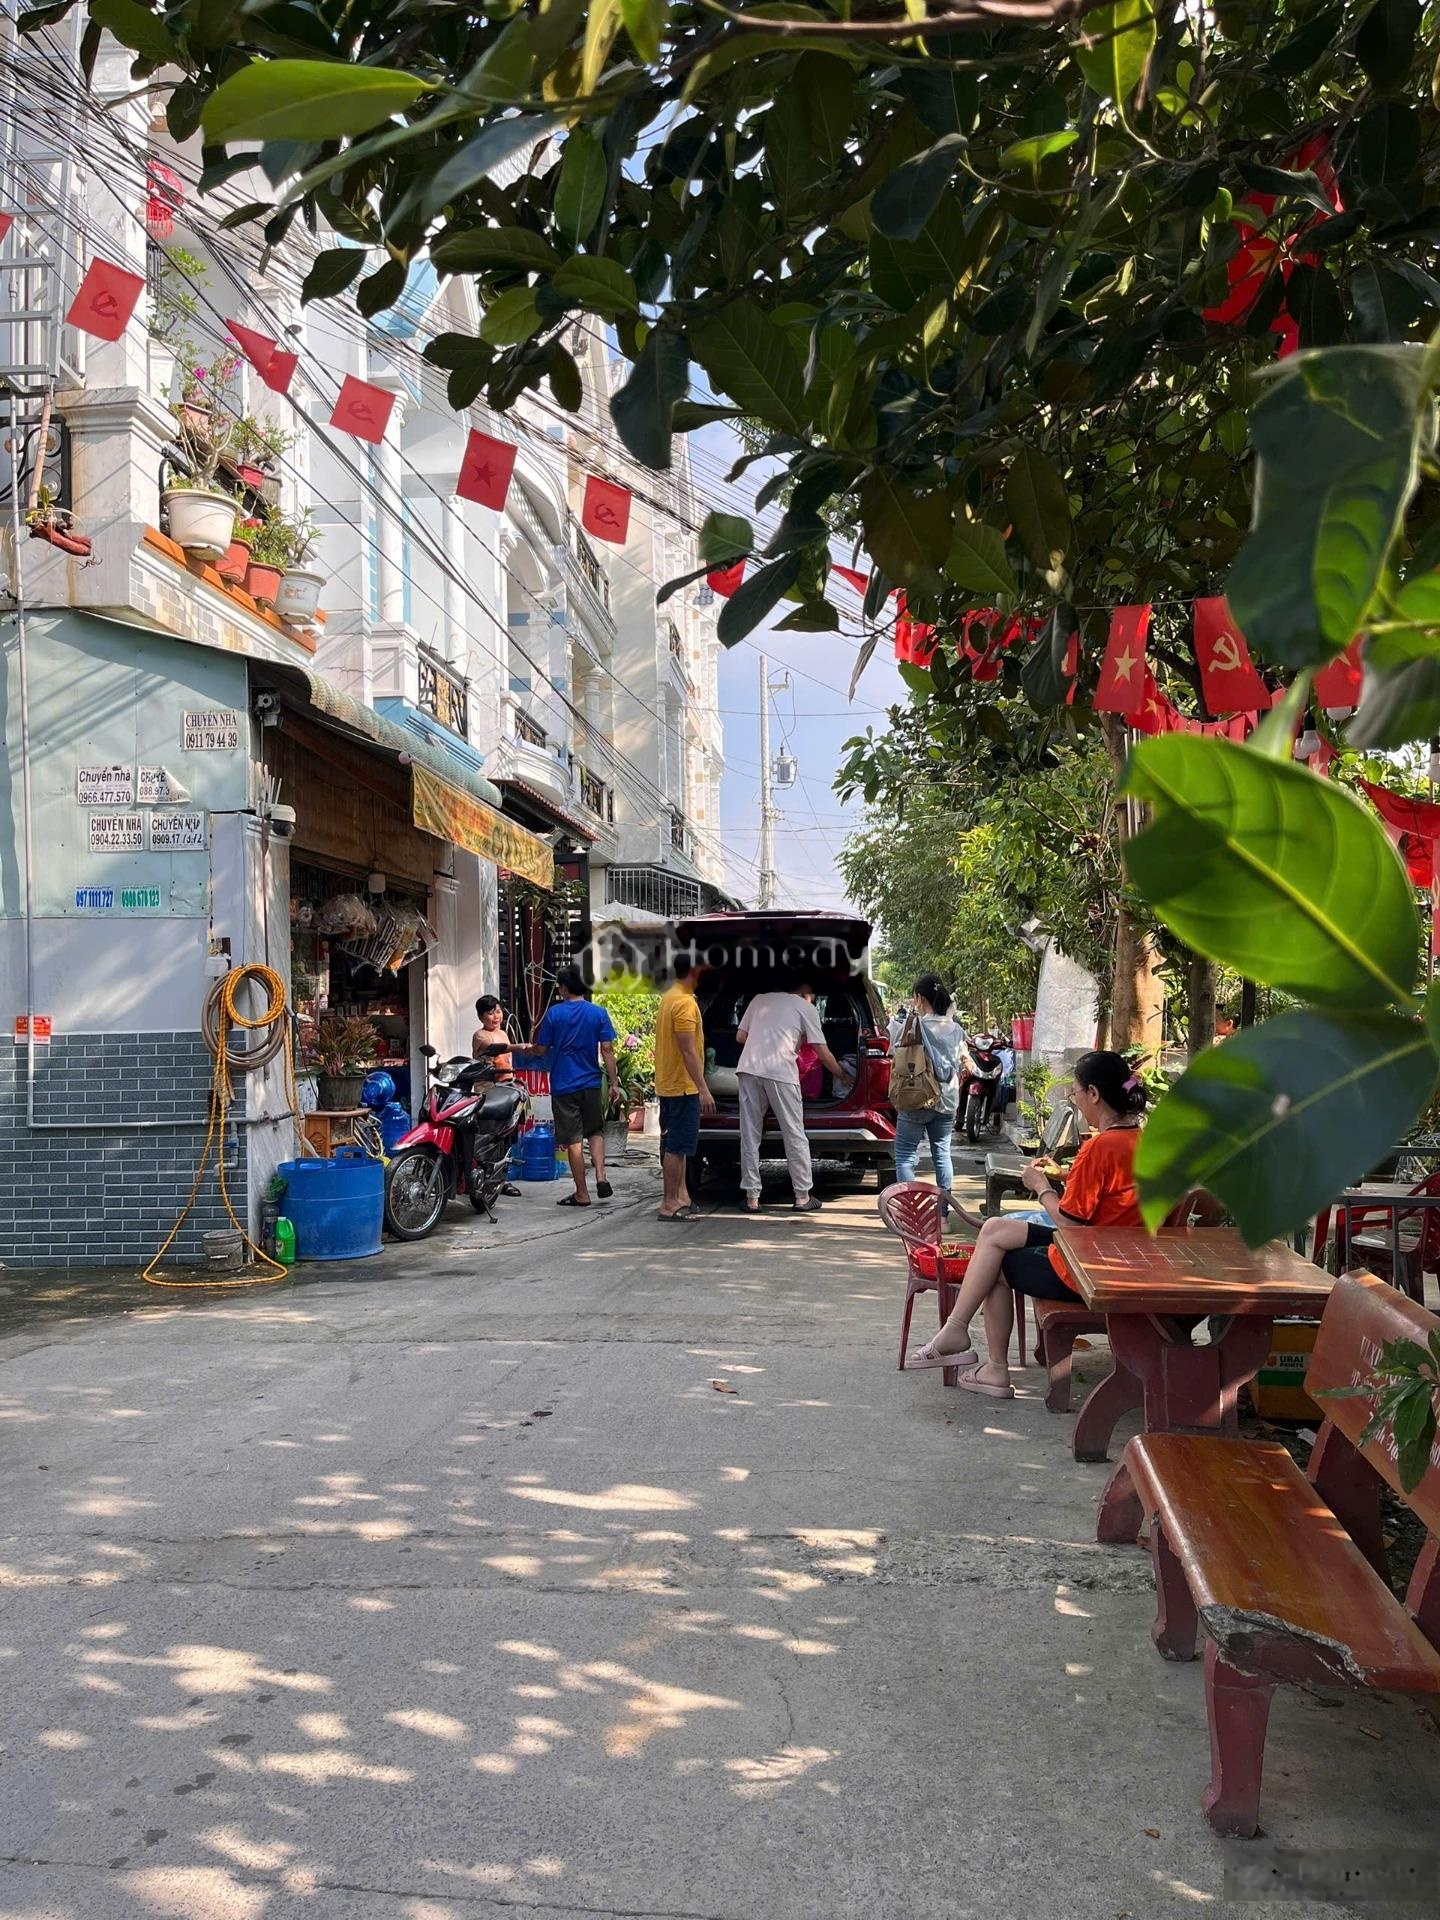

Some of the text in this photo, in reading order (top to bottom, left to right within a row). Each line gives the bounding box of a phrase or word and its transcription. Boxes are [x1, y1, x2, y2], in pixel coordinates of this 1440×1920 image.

[186, 732, 238, 748] 0911 79 44 39
[79, 791, 131, 803] 0966.477.570
[91, 833, 142, 845] 0904.22.33.50
